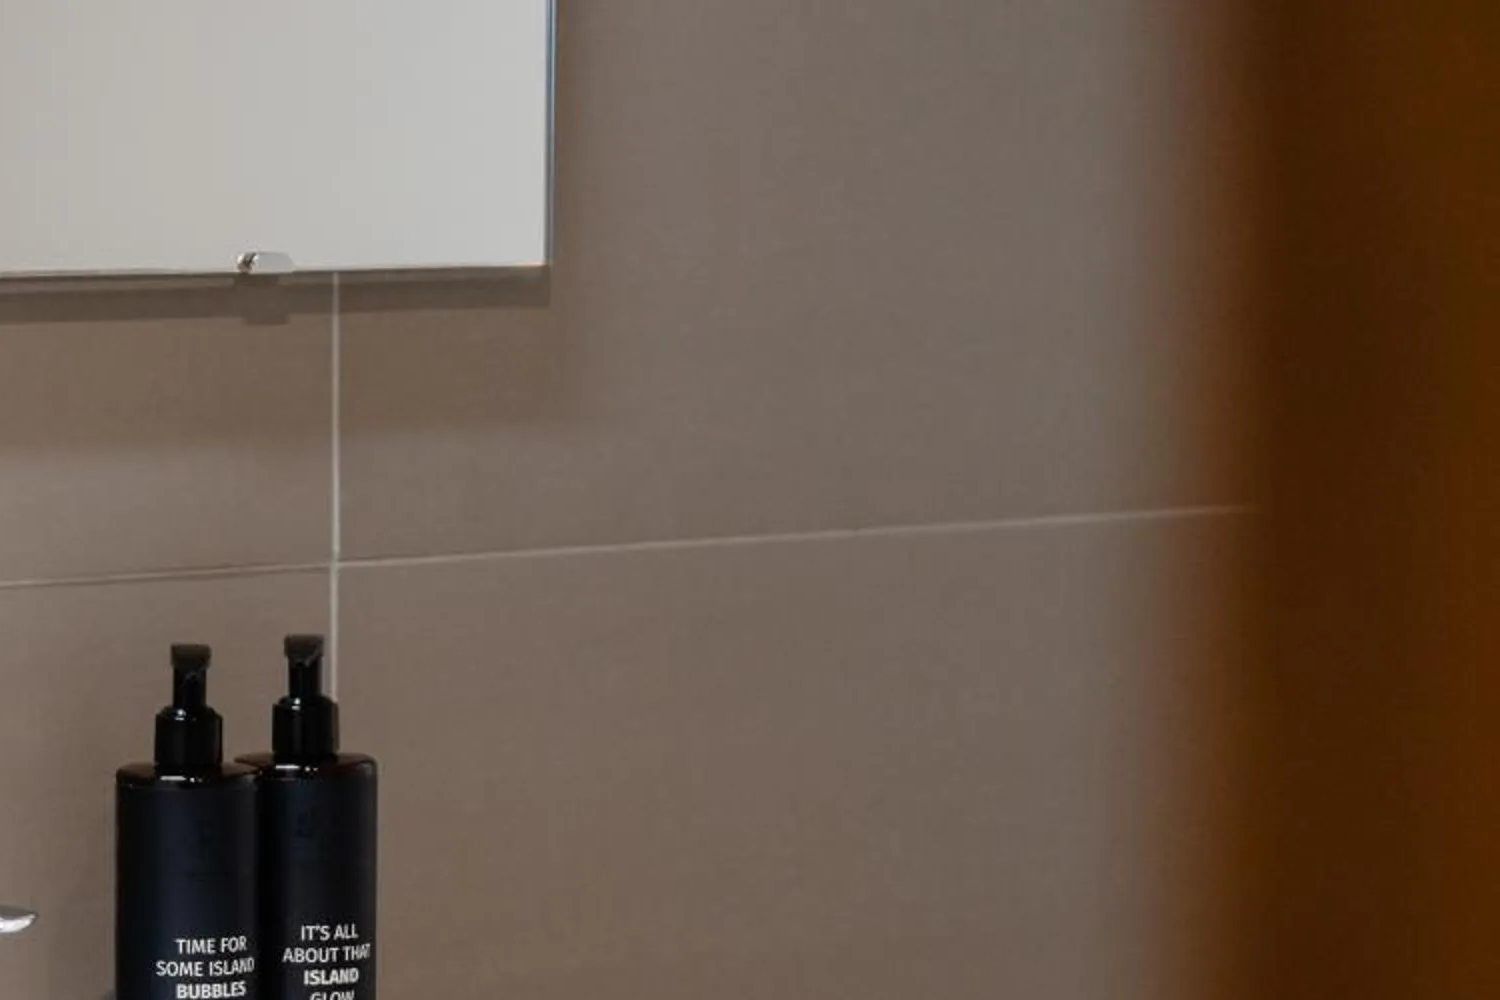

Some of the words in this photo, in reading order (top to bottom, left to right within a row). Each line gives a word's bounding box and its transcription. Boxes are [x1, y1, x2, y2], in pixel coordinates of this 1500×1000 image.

[301, 923, 330, 941] IT'S
[334, 923, 359, 940] ALL
[176, 938, 216, 954] TIME
[221, 936, 247, 953] FOR
[282, 946, 339, 963] ABOUT
[342, 943, 371, 961] THAT
[156, 960, 203, 977] SOME
[209, 956, 255, 977] ISLAND
[303, 967, 359, 986] ISLAND
[177, 981, 247, 1000] BUBBLES
